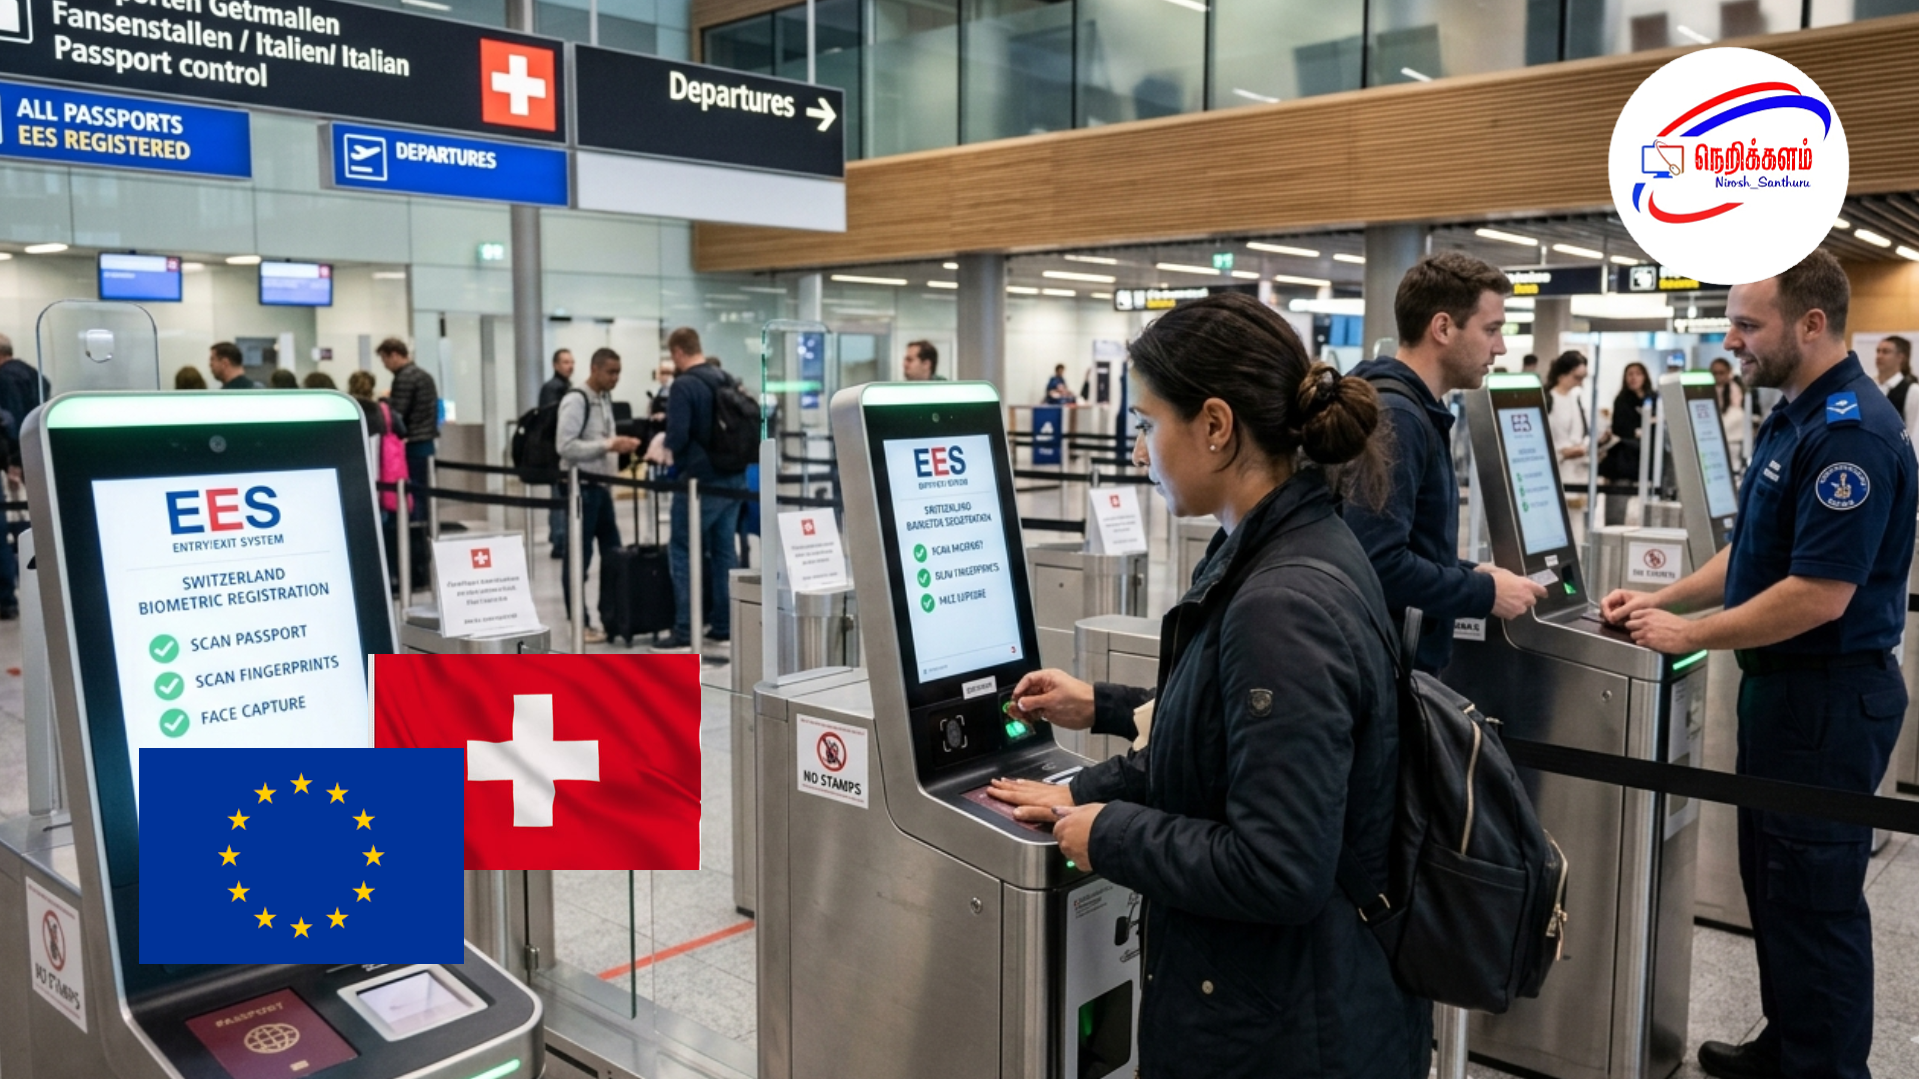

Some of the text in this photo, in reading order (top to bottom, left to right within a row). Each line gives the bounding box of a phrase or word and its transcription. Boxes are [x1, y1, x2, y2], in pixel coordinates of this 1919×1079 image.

[53, 1, 233, 50] Fansenstallen
[342, 45, 410, 77] Italian
[55, 35, 268, 87] Passport control
[669, 70, 795, 118] Departures
[17, 98, 183, 134] ALL PASSPORTS
[18, 125, 191, 160] EES REGISTERED
[395, 141, 497, 169] DEPARTURES
[914, 445, 966, 477] EES
[165, 485, 281, 535] EES
[240, 534, 284, 548] SYSTEM
[182, 567, 286, 591] SWITZERLAND
[138, 582, 330, 616] BIOMETRIC REGISTRATION
[191, 624, 308, 652] SCAN PASSPORT
[195, 655, 340, 688] SCAN FINGERPRINTS
[201, 695, 306, 724] FACE CAPTURE
[803, 769, 862, 796] NO STAMPS
